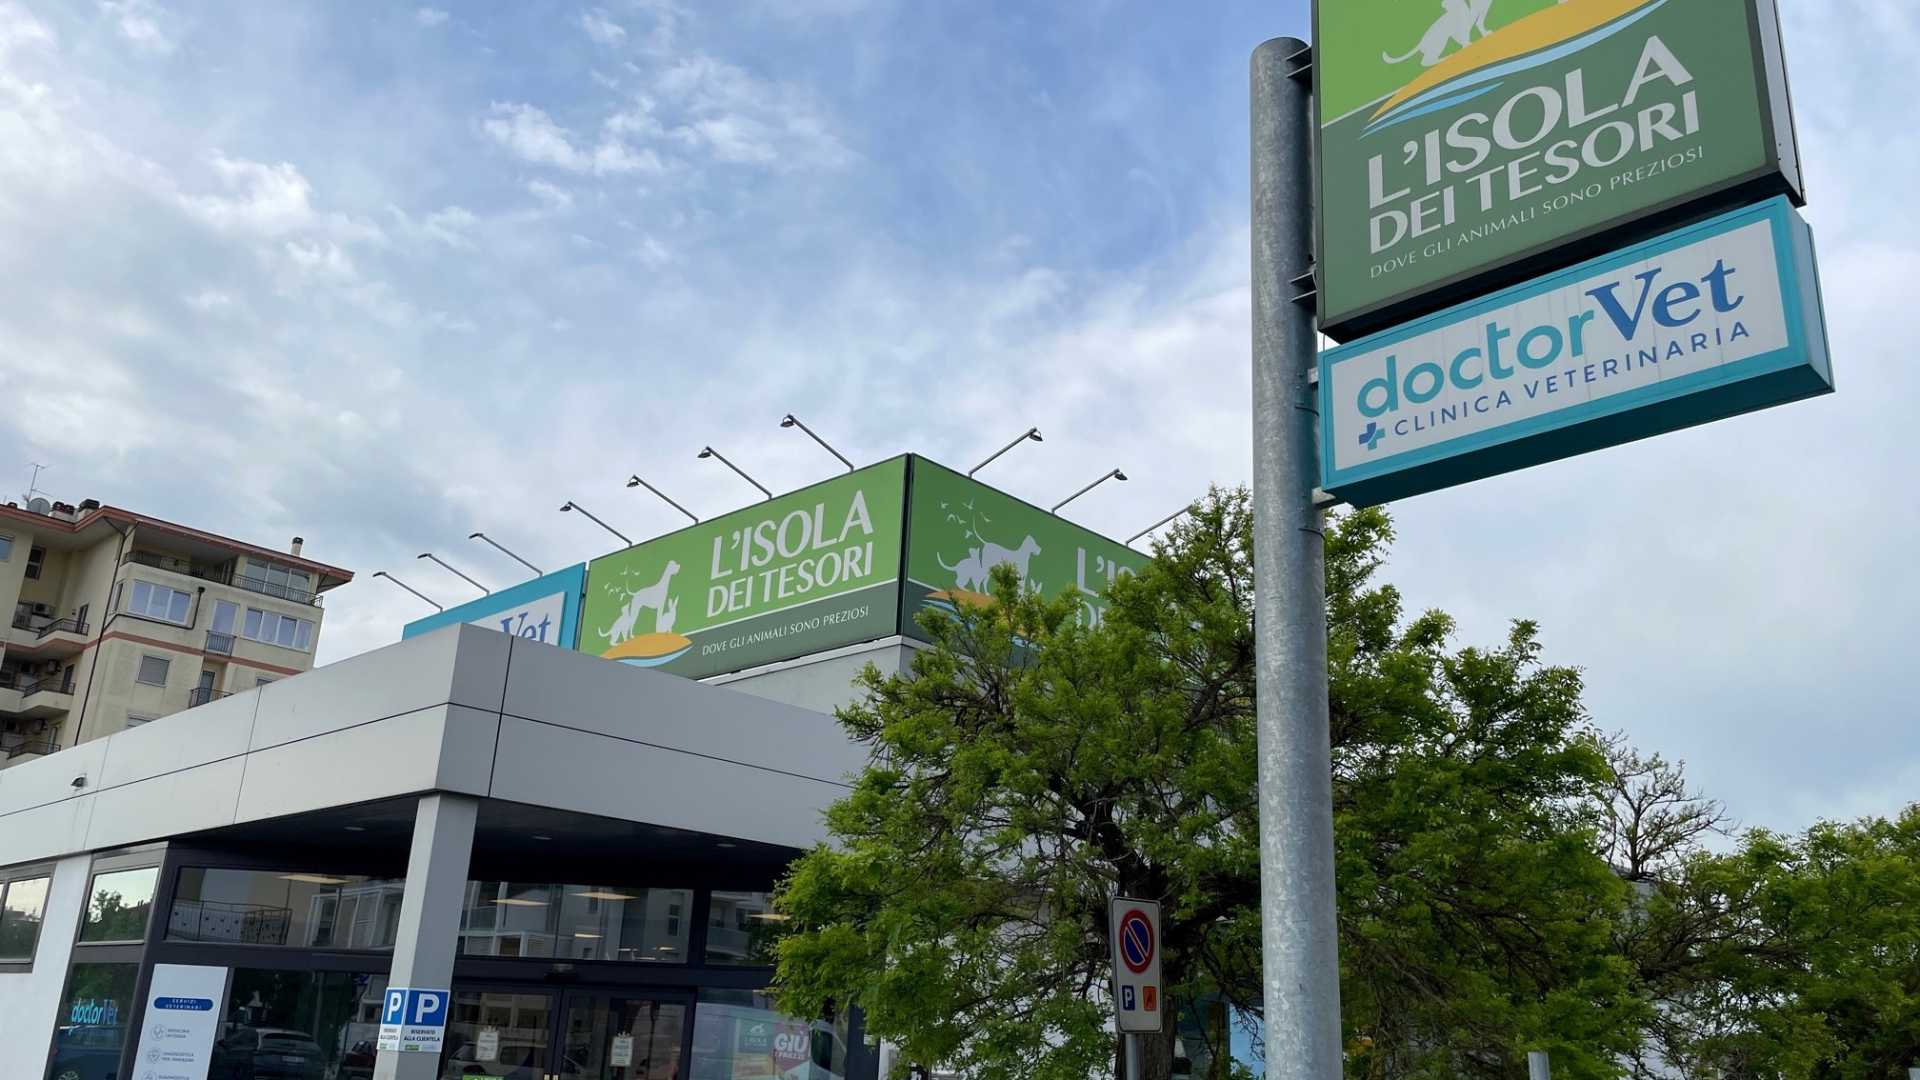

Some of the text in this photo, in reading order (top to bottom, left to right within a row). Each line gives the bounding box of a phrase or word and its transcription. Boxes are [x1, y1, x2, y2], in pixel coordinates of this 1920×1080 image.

[1368, 35, 1694, 209] L'ISOLA
[1370, 90, 1700, 255] DEI TESORI
[1370, 145, 1704, 279] DOVE GLI ANIMALI SONO PREZIOSI
[1356, 258, 1745, 418] doctorVet
[1394, 320, 1750, 436] CLINICA VETERINARIA
[706, 541, 873, 618] DEI TESORI
[710, 489, 874, 580] L'ISOLA
[702, 604, 869, 656] DOVE GLI ANIMALI SONO PREZIOSI
[387, 992, 402, 1022] P
[415, 992, 440, 1023] P
[1124, 989, 1133, 1008] P
